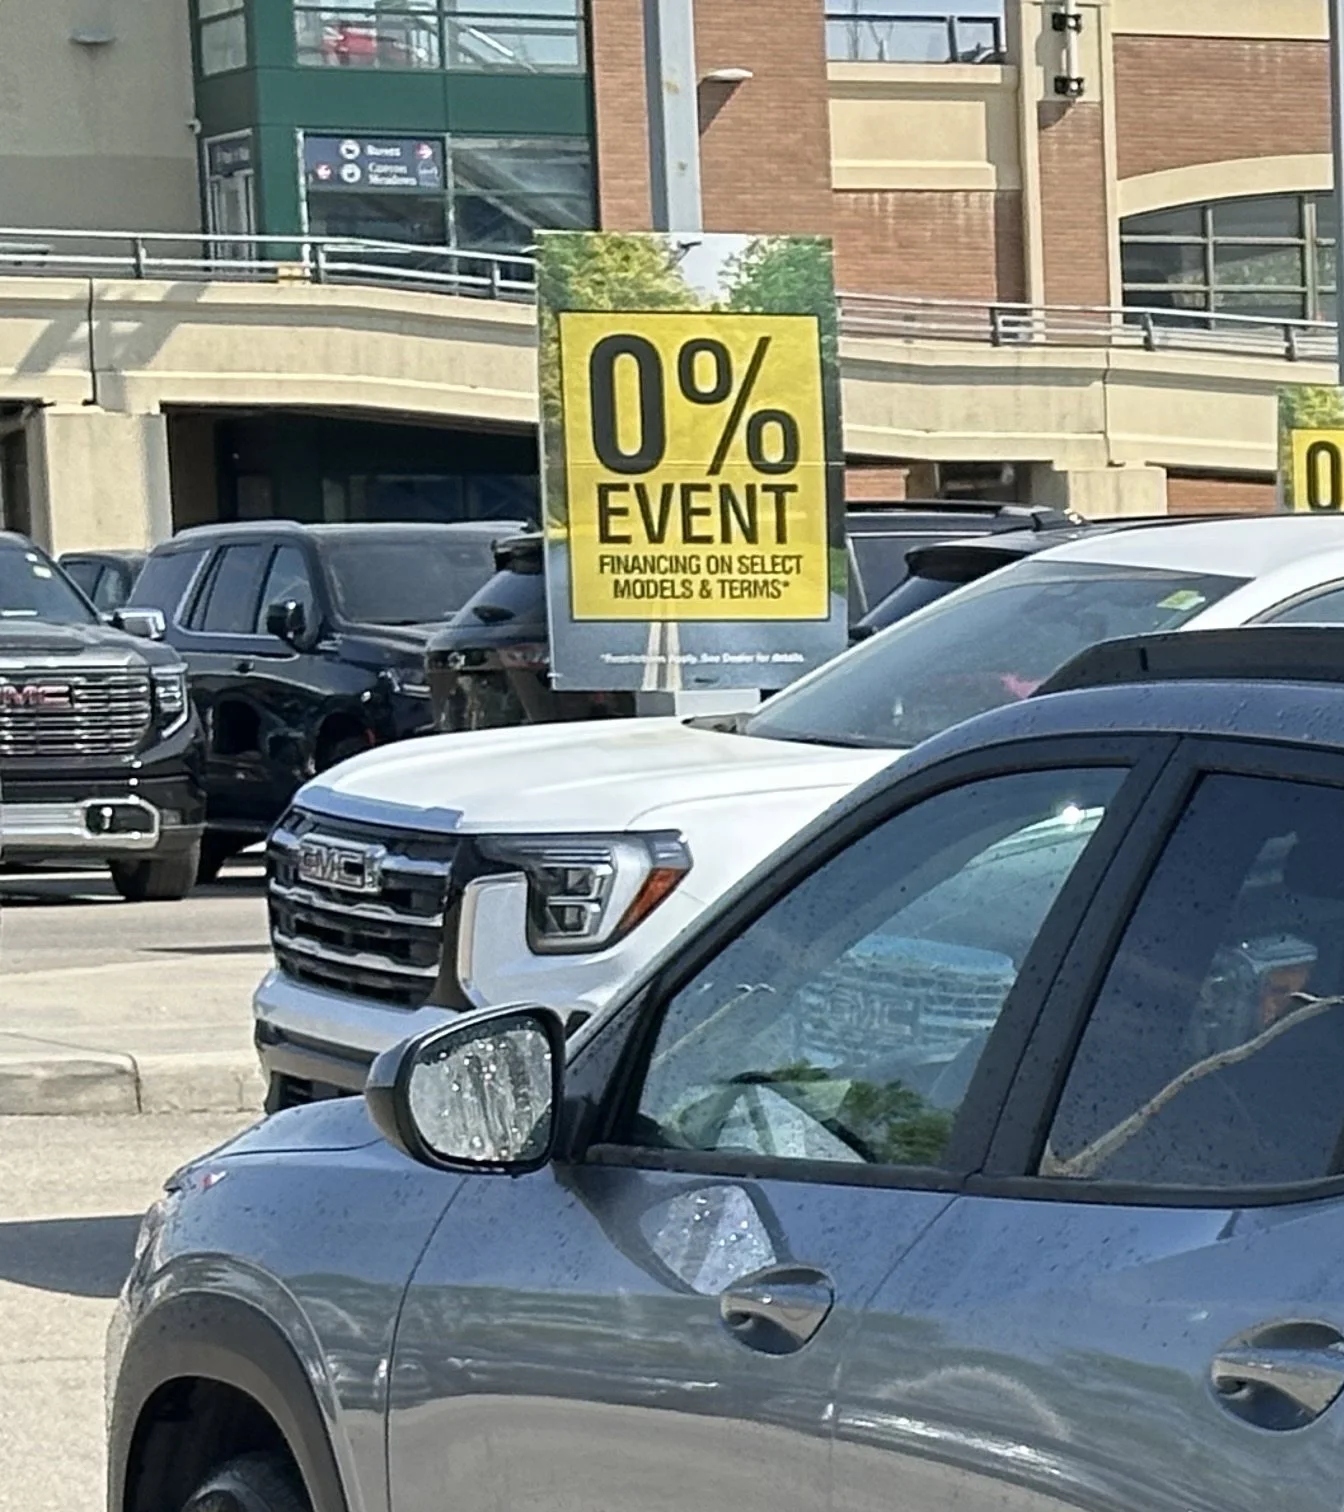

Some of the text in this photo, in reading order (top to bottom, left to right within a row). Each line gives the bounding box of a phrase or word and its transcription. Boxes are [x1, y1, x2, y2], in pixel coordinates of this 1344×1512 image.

[588, 333, 800, 477] 0%
[596, 482, 798, 545] EVENT
[598, 554, 803, 576] FINANCING ON SELECT
[613, 578, 694, 600] MODELS
[698, 579, 713, 600] &
[299, 846, 365, 886] GMC
